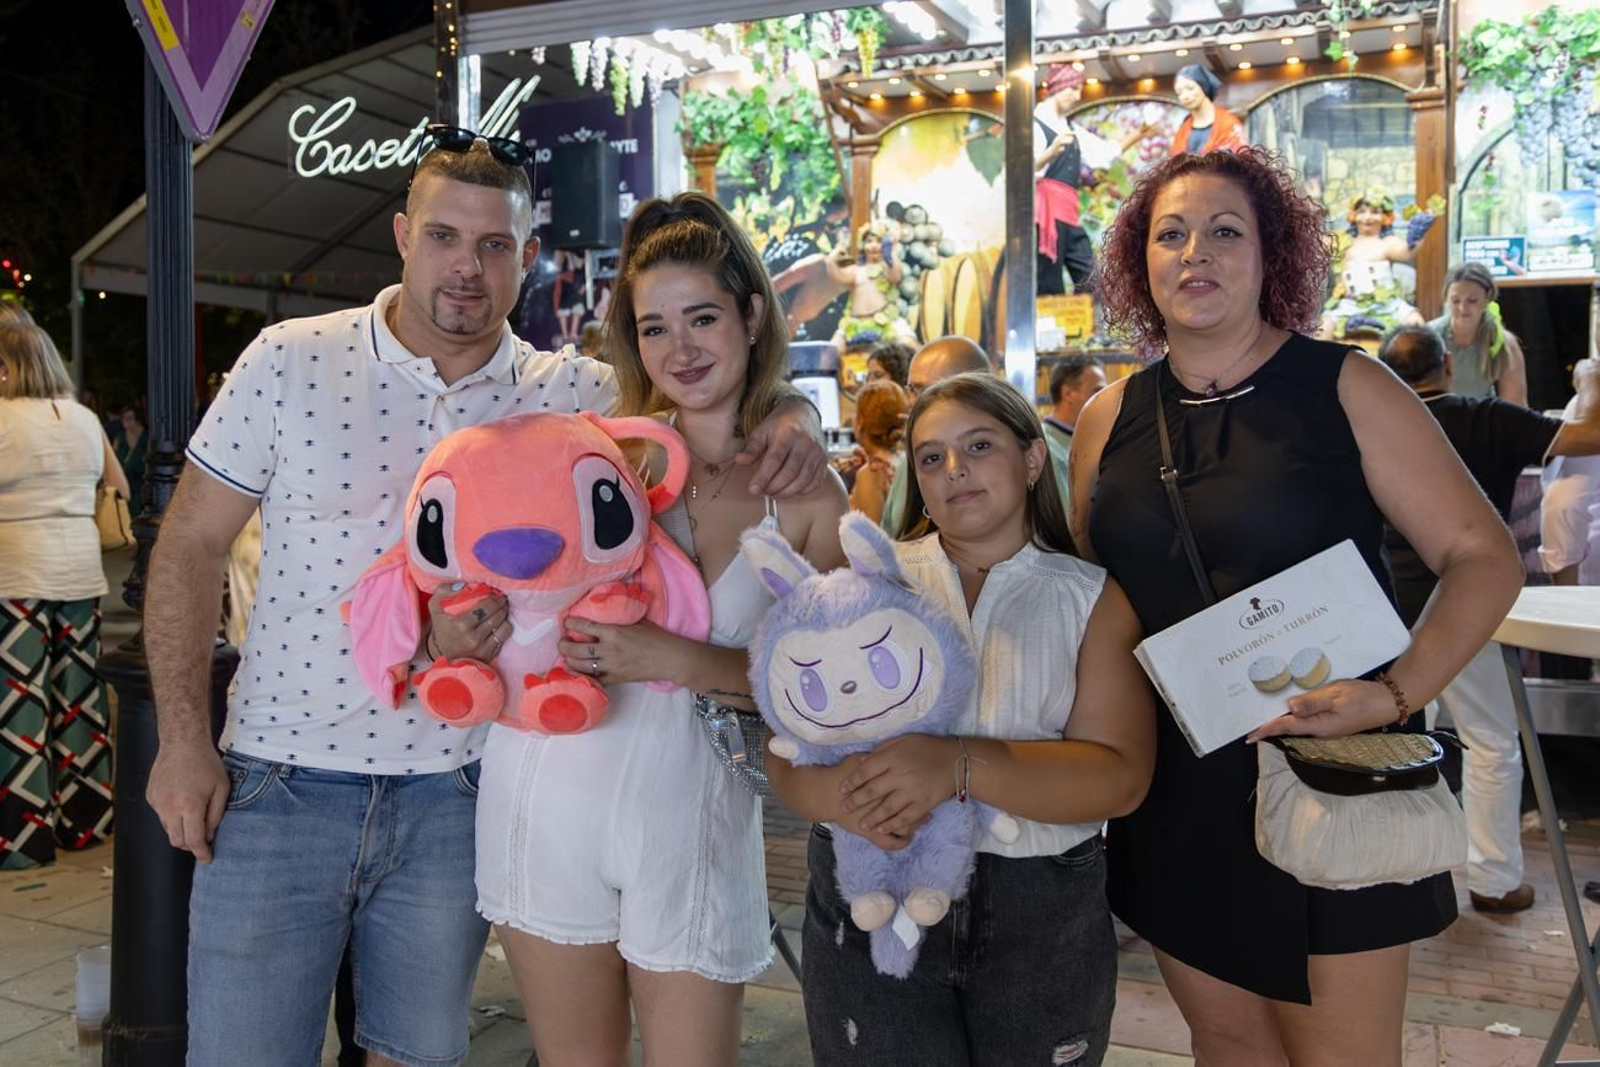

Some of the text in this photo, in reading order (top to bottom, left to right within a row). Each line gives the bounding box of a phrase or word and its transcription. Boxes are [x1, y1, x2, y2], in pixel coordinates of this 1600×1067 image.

[1217, 605, 1329, 666] POLVORÓN TURRÓN
[1246, 605, 1280, 626] GAMITO
